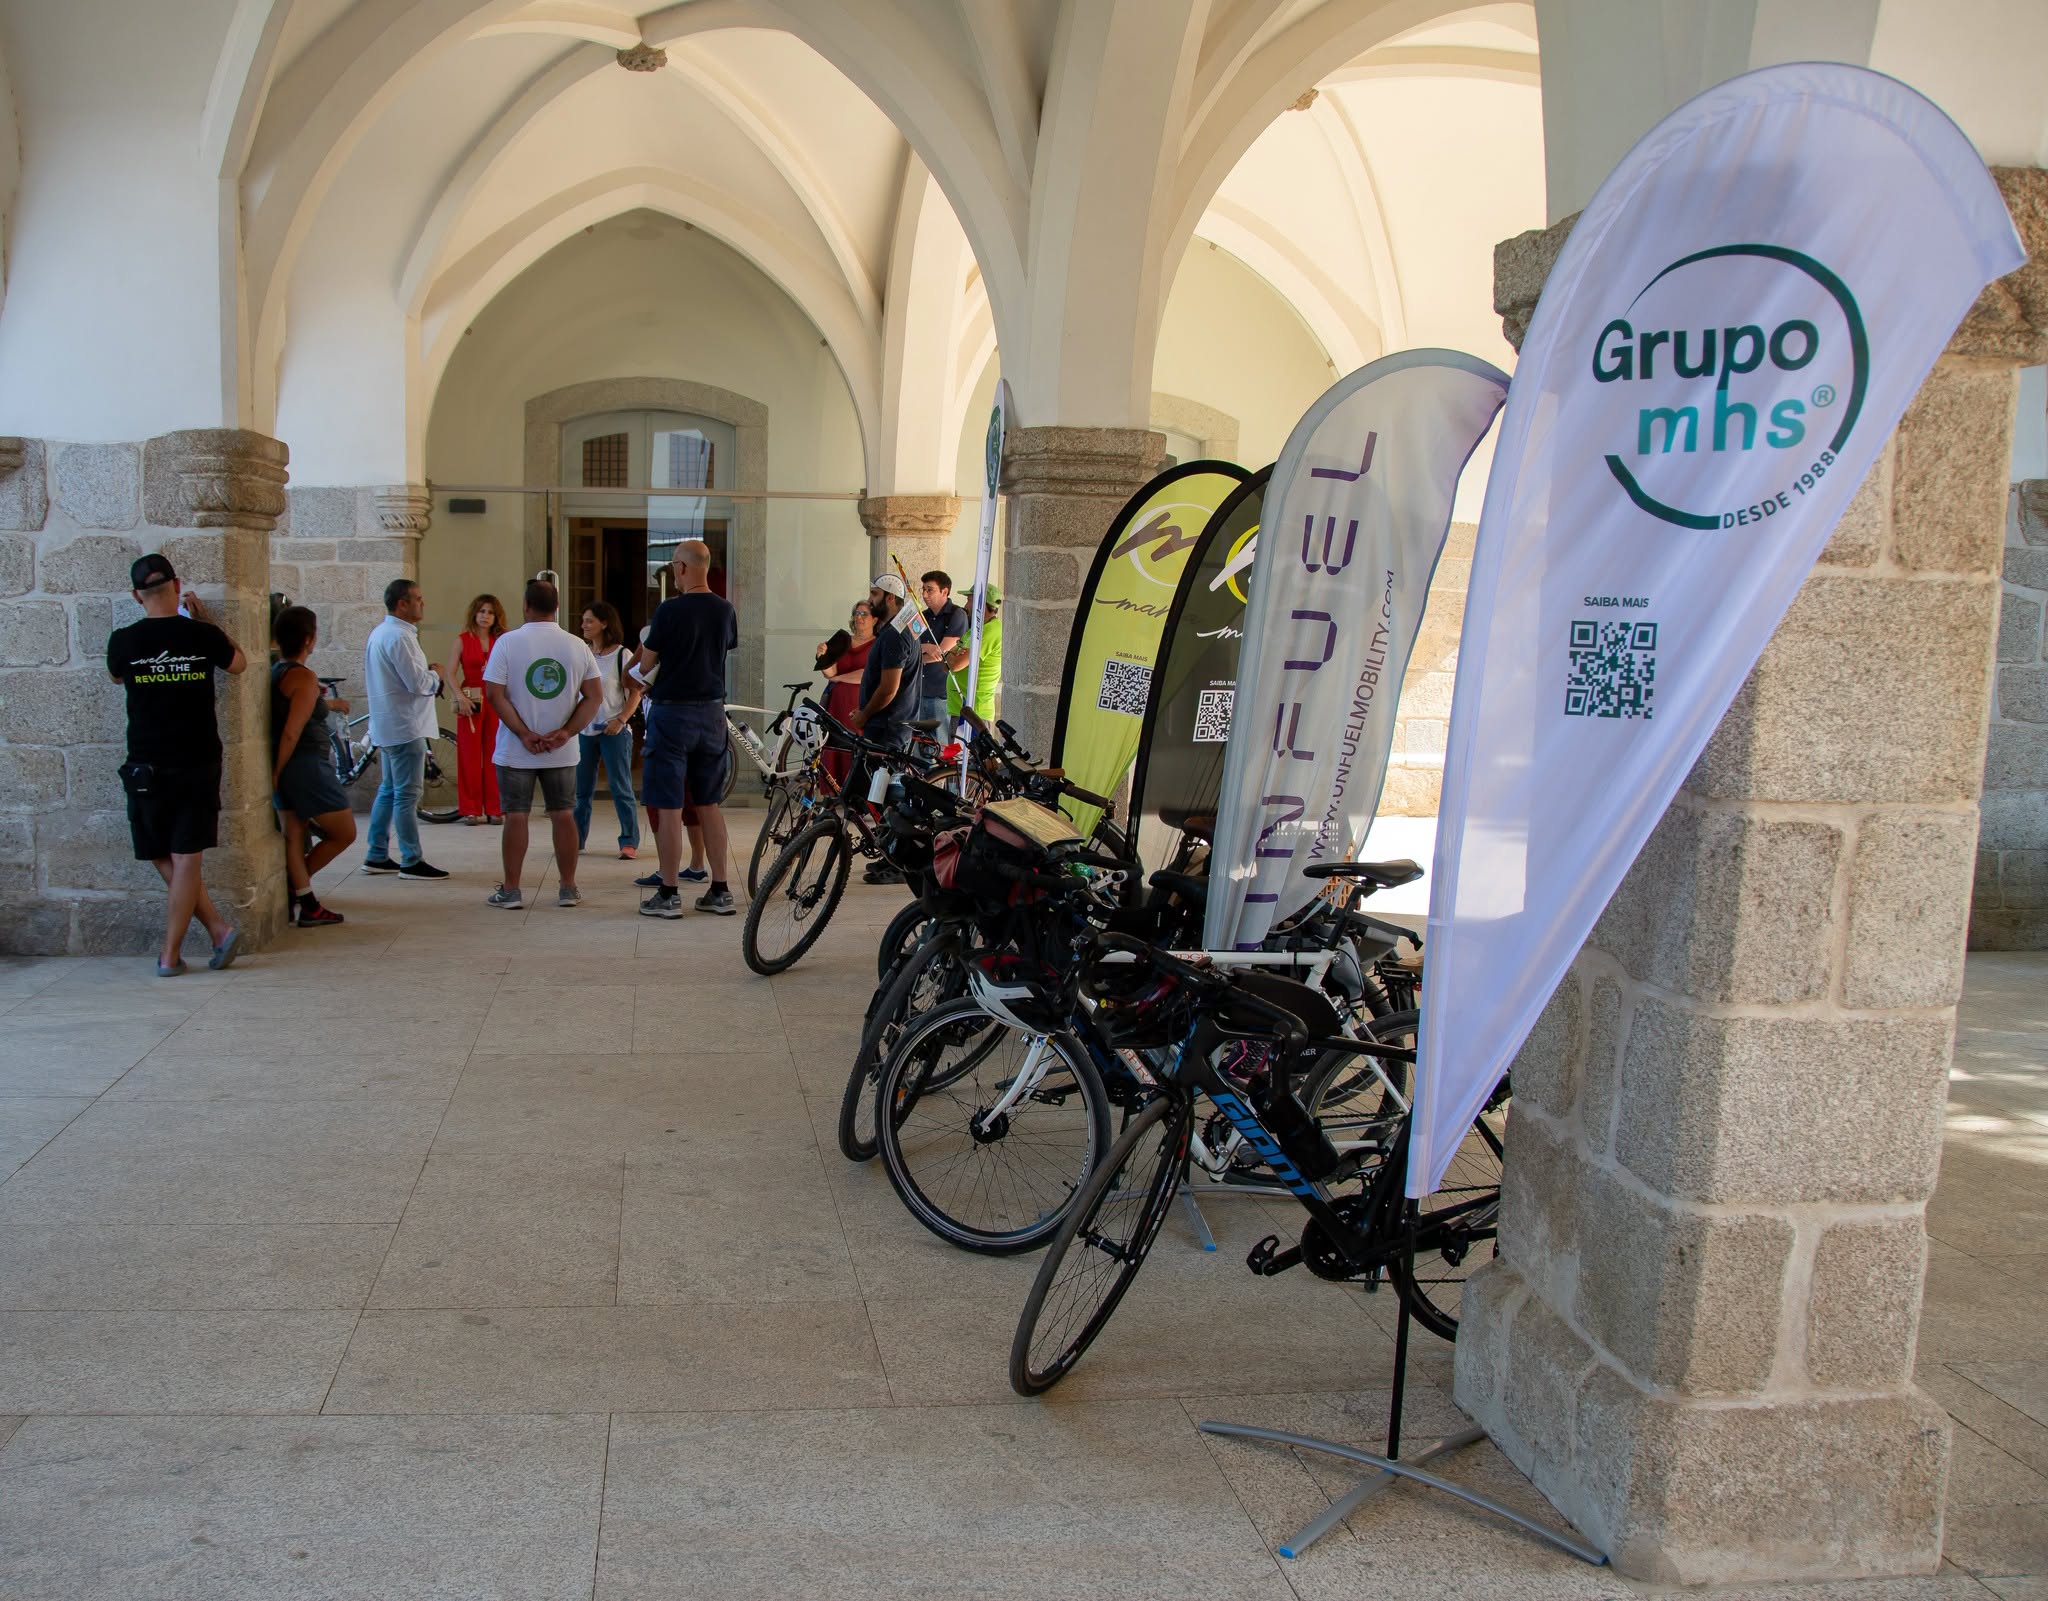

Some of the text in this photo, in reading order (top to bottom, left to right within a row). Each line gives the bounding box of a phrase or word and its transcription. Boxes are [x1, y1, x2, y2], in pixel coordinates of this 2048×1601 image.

[1592, 319, 1820, 391] Grupo
[1723, 450, 1836, 529] DESDE 1988
[1583, 596, 1650, 608] SAIBA MAIS
[130, 650, 207, 665] welcome
[1115, 651, 1148, 662] SAIBA MAIS
[150, 663, 191, 673] TO THE
[134, 672, 206, 684] REVOLUTION
[1208, 1092, 1324, 1202] GIANT
